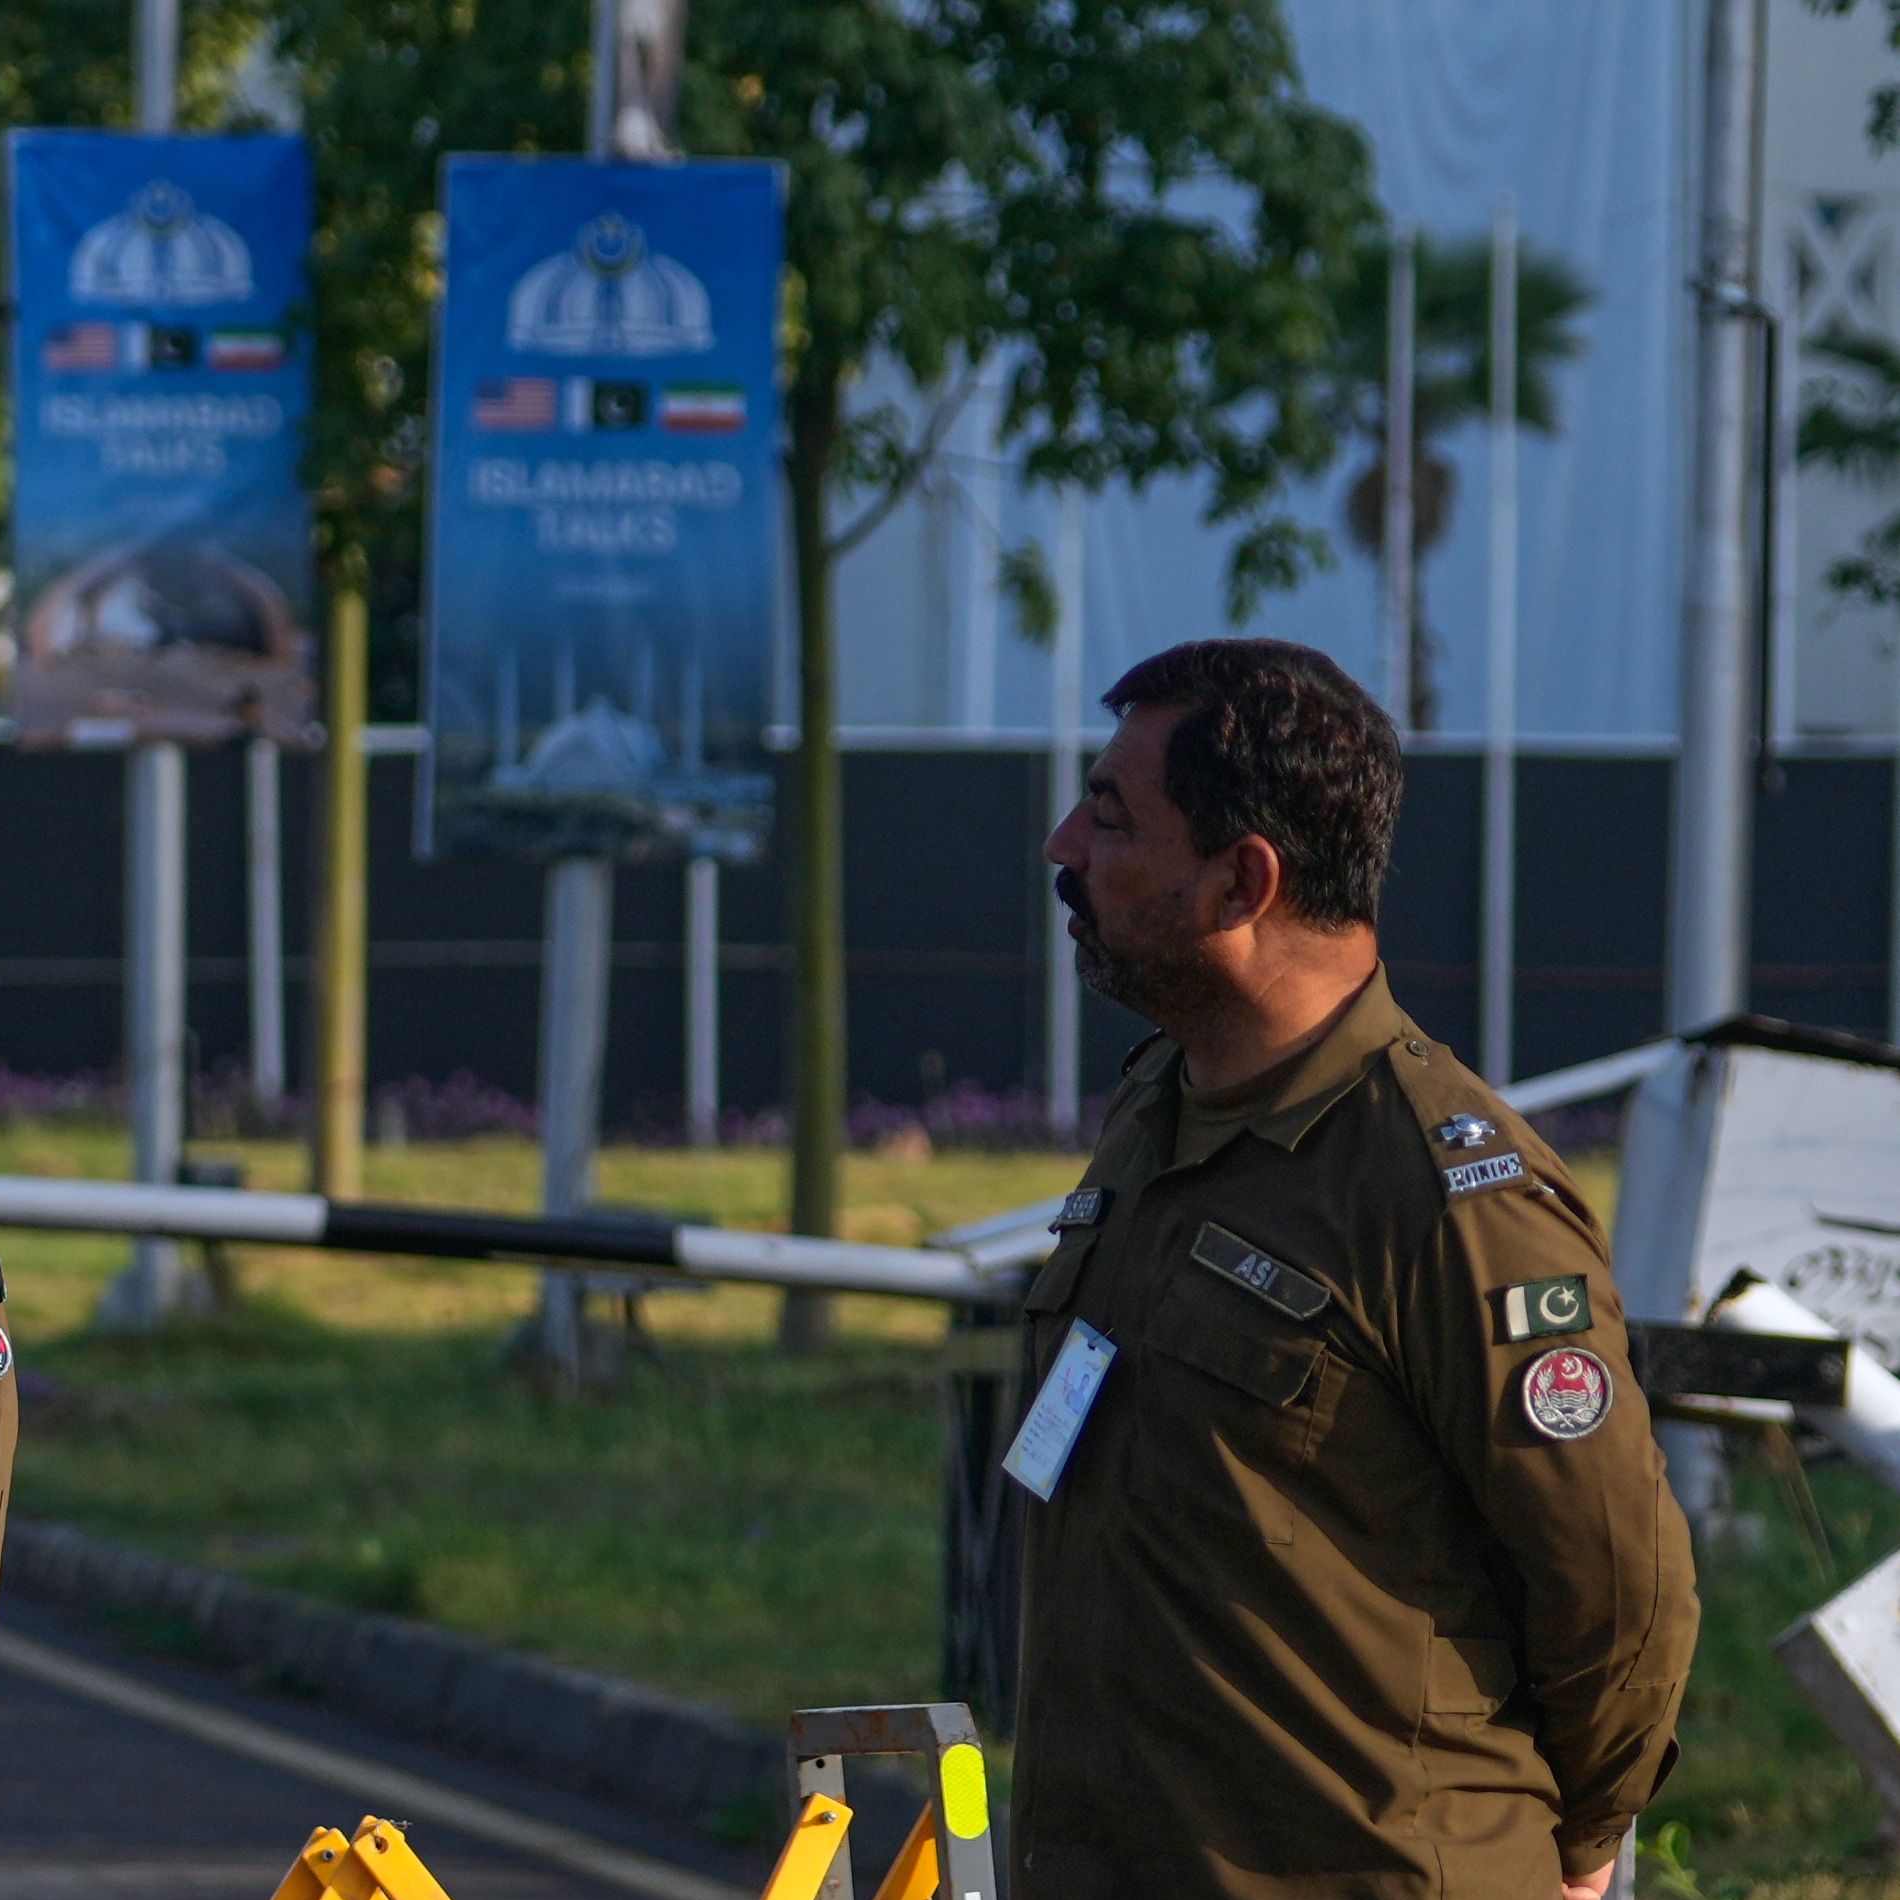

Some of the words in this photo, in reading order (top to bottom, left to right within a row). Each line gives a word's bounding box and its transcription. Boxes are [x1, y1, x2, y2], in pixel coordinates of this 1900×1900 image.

[40, 392, 283, 437] ISLAMABAD
[468, 459, 742, 507] ISLAMABAD
[535, 504, 679, 551] TALKS
[1233, 1254, 1280, 1291] ASI
